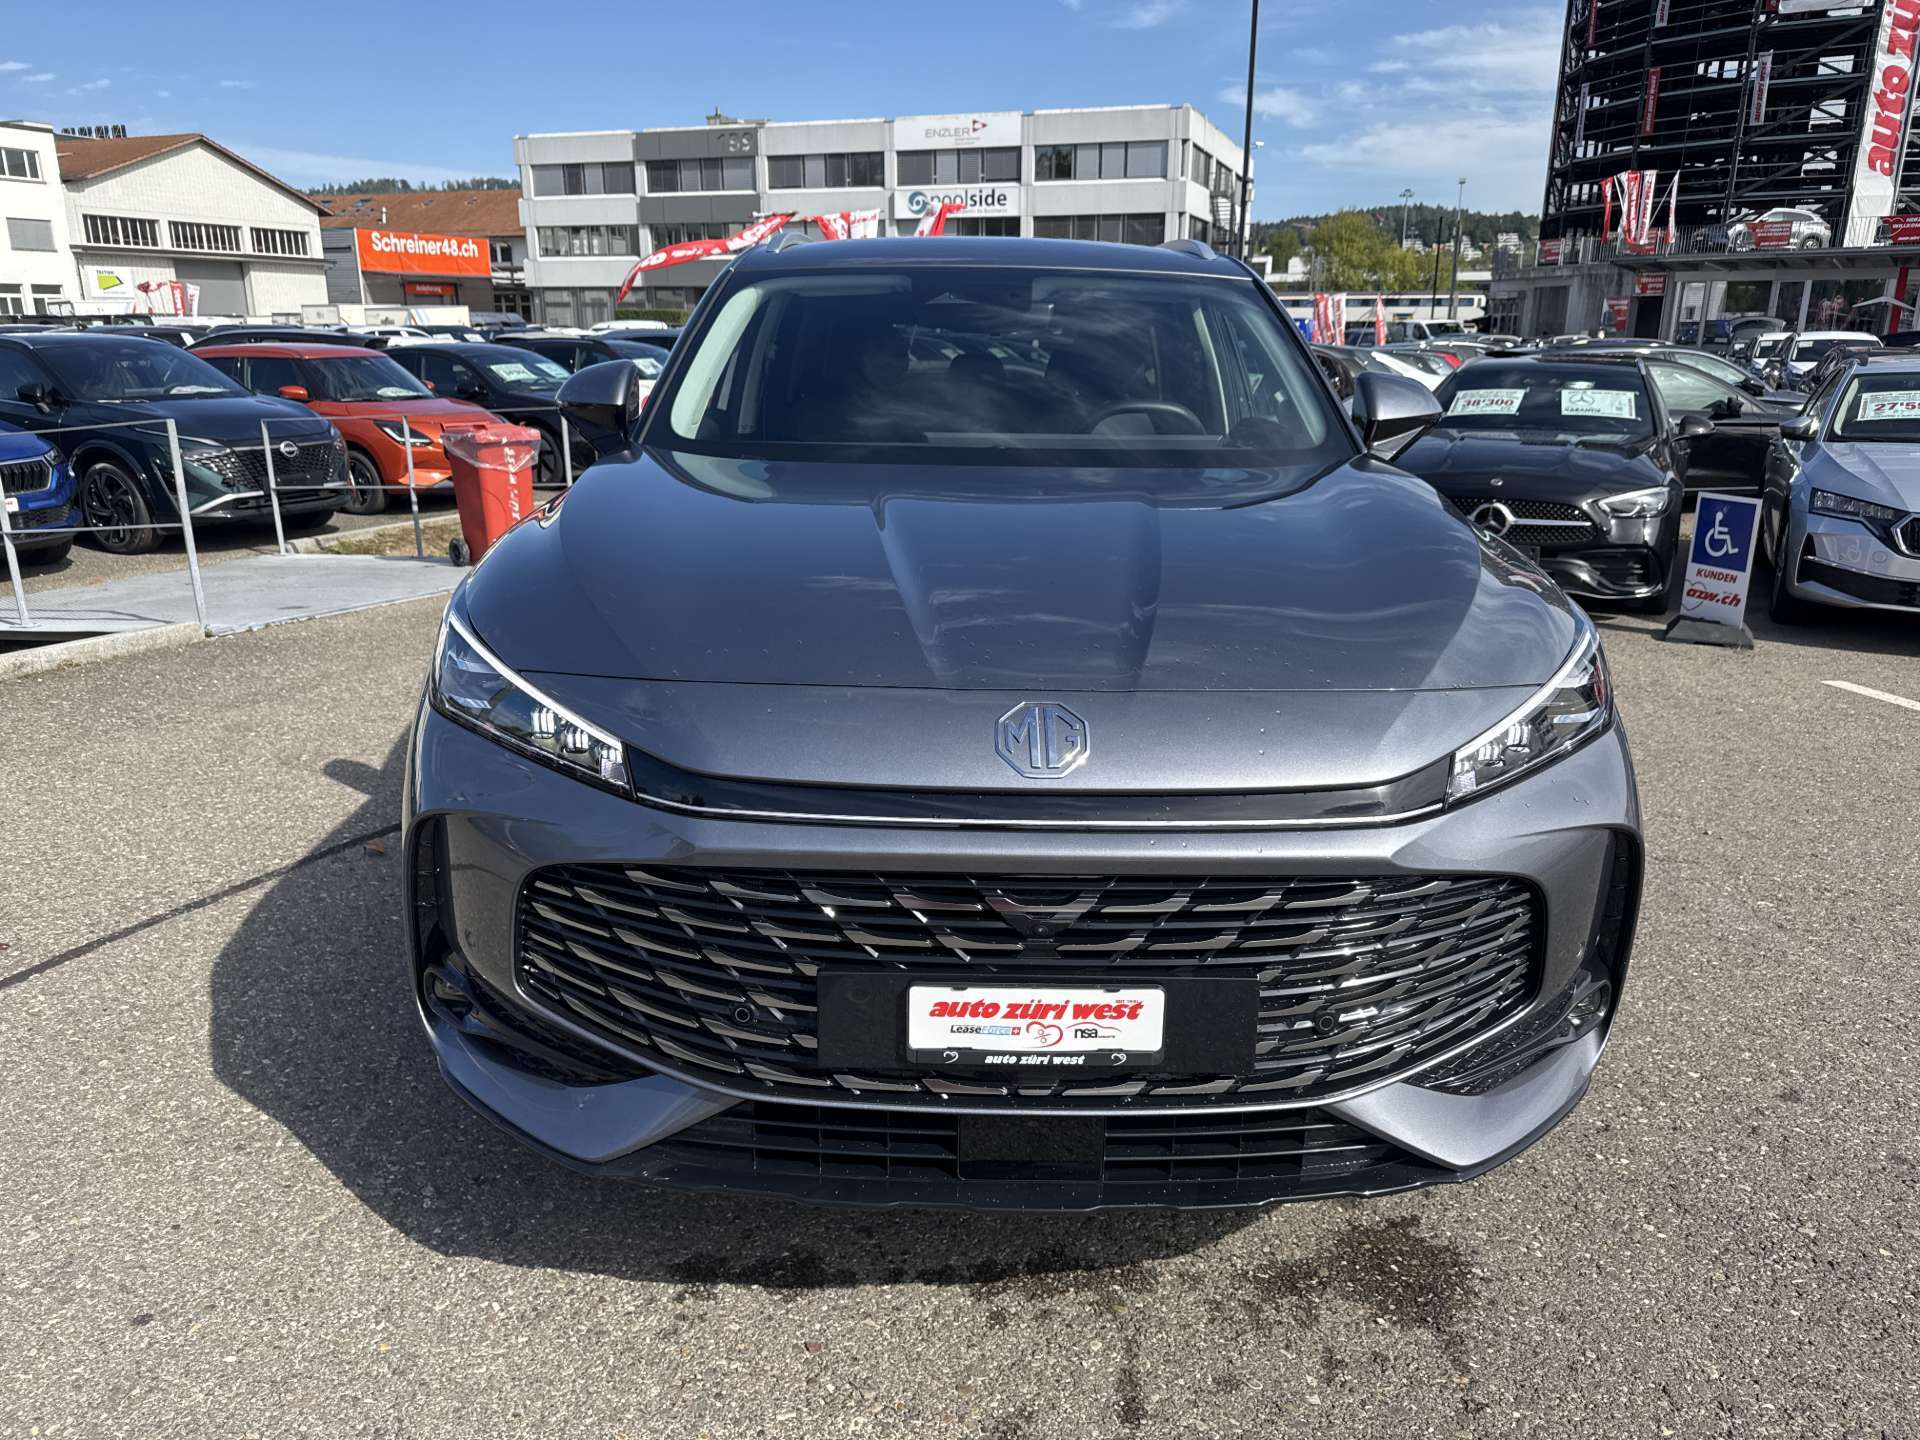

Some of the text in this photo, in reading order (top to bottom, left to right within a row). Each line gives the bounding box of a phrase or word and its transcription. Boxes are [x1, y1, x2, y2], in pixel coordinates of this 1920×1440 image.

[1868, 65, 1909, 176] auto
[925, 127, 971, 138] ENZLER
[371, 231, 479, 258] Schreiner48.ch
[1874, 402, 1920, 411] 27'5
[1696, 568, 1738, 584] KUNDEN
[1686, 588, 1741, 607] azw.ch
[1004, 706, 1080, 769] MG
[928, 998, 1144, 1020] auto züri west
[1074, 1027, 1098, 1039] nsa
[985, 1054, 1086, 1065] auto züri west
